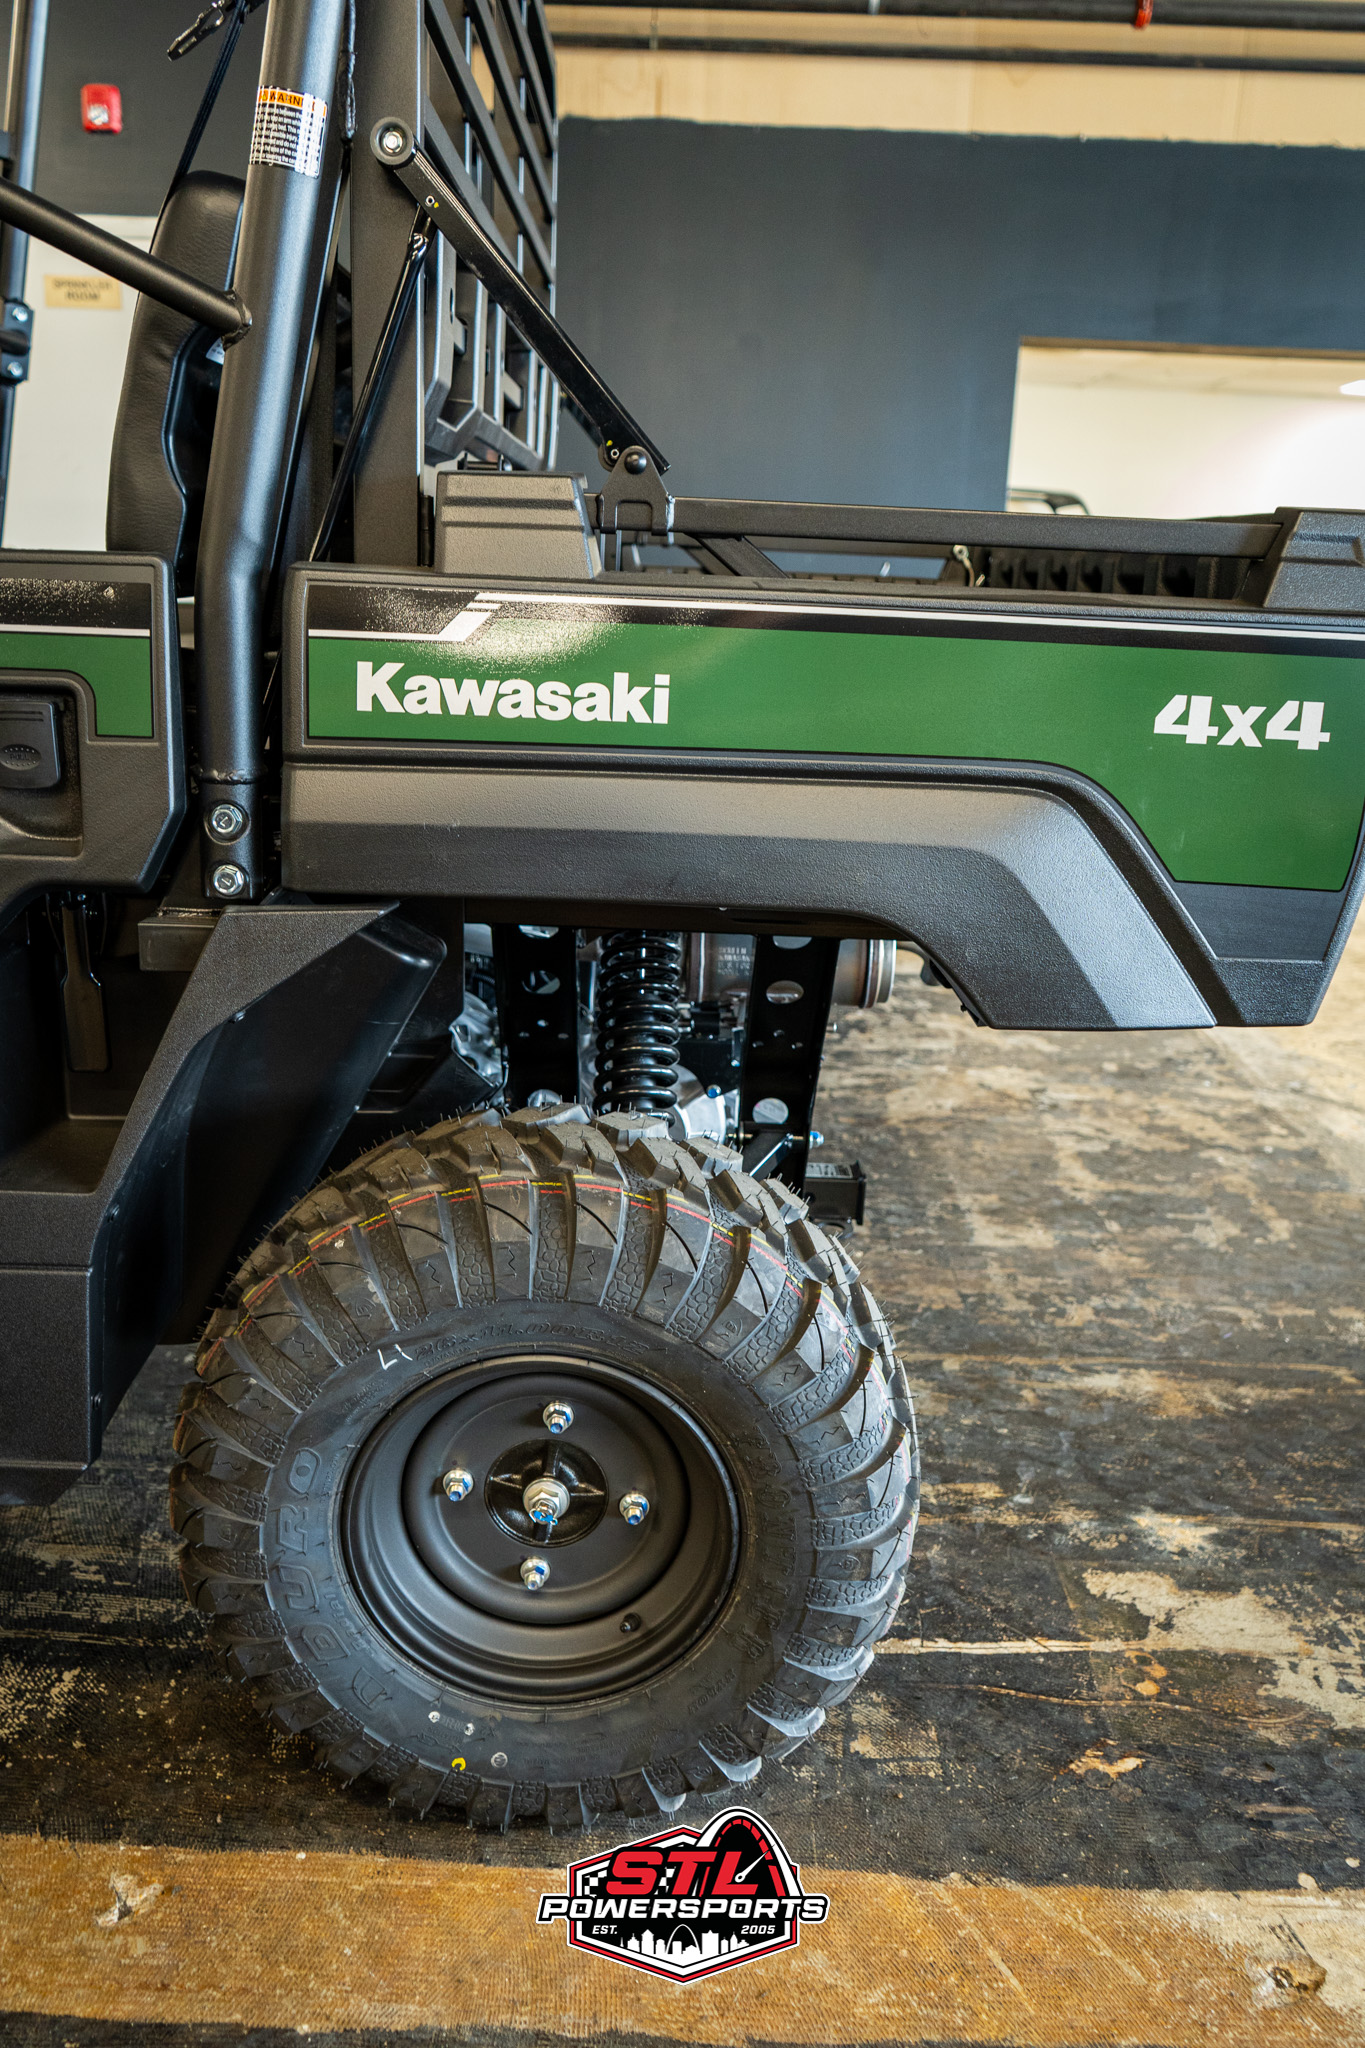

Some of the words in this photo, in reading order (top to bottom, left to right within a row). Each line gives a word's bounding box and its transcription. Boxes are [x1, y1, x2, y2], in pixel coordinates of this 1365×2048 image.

[356, 660, 671, 725] Kawasaki
[1153, 694, 1331, 751] 4x4
[275, 1447, 351, 1662] DURO
